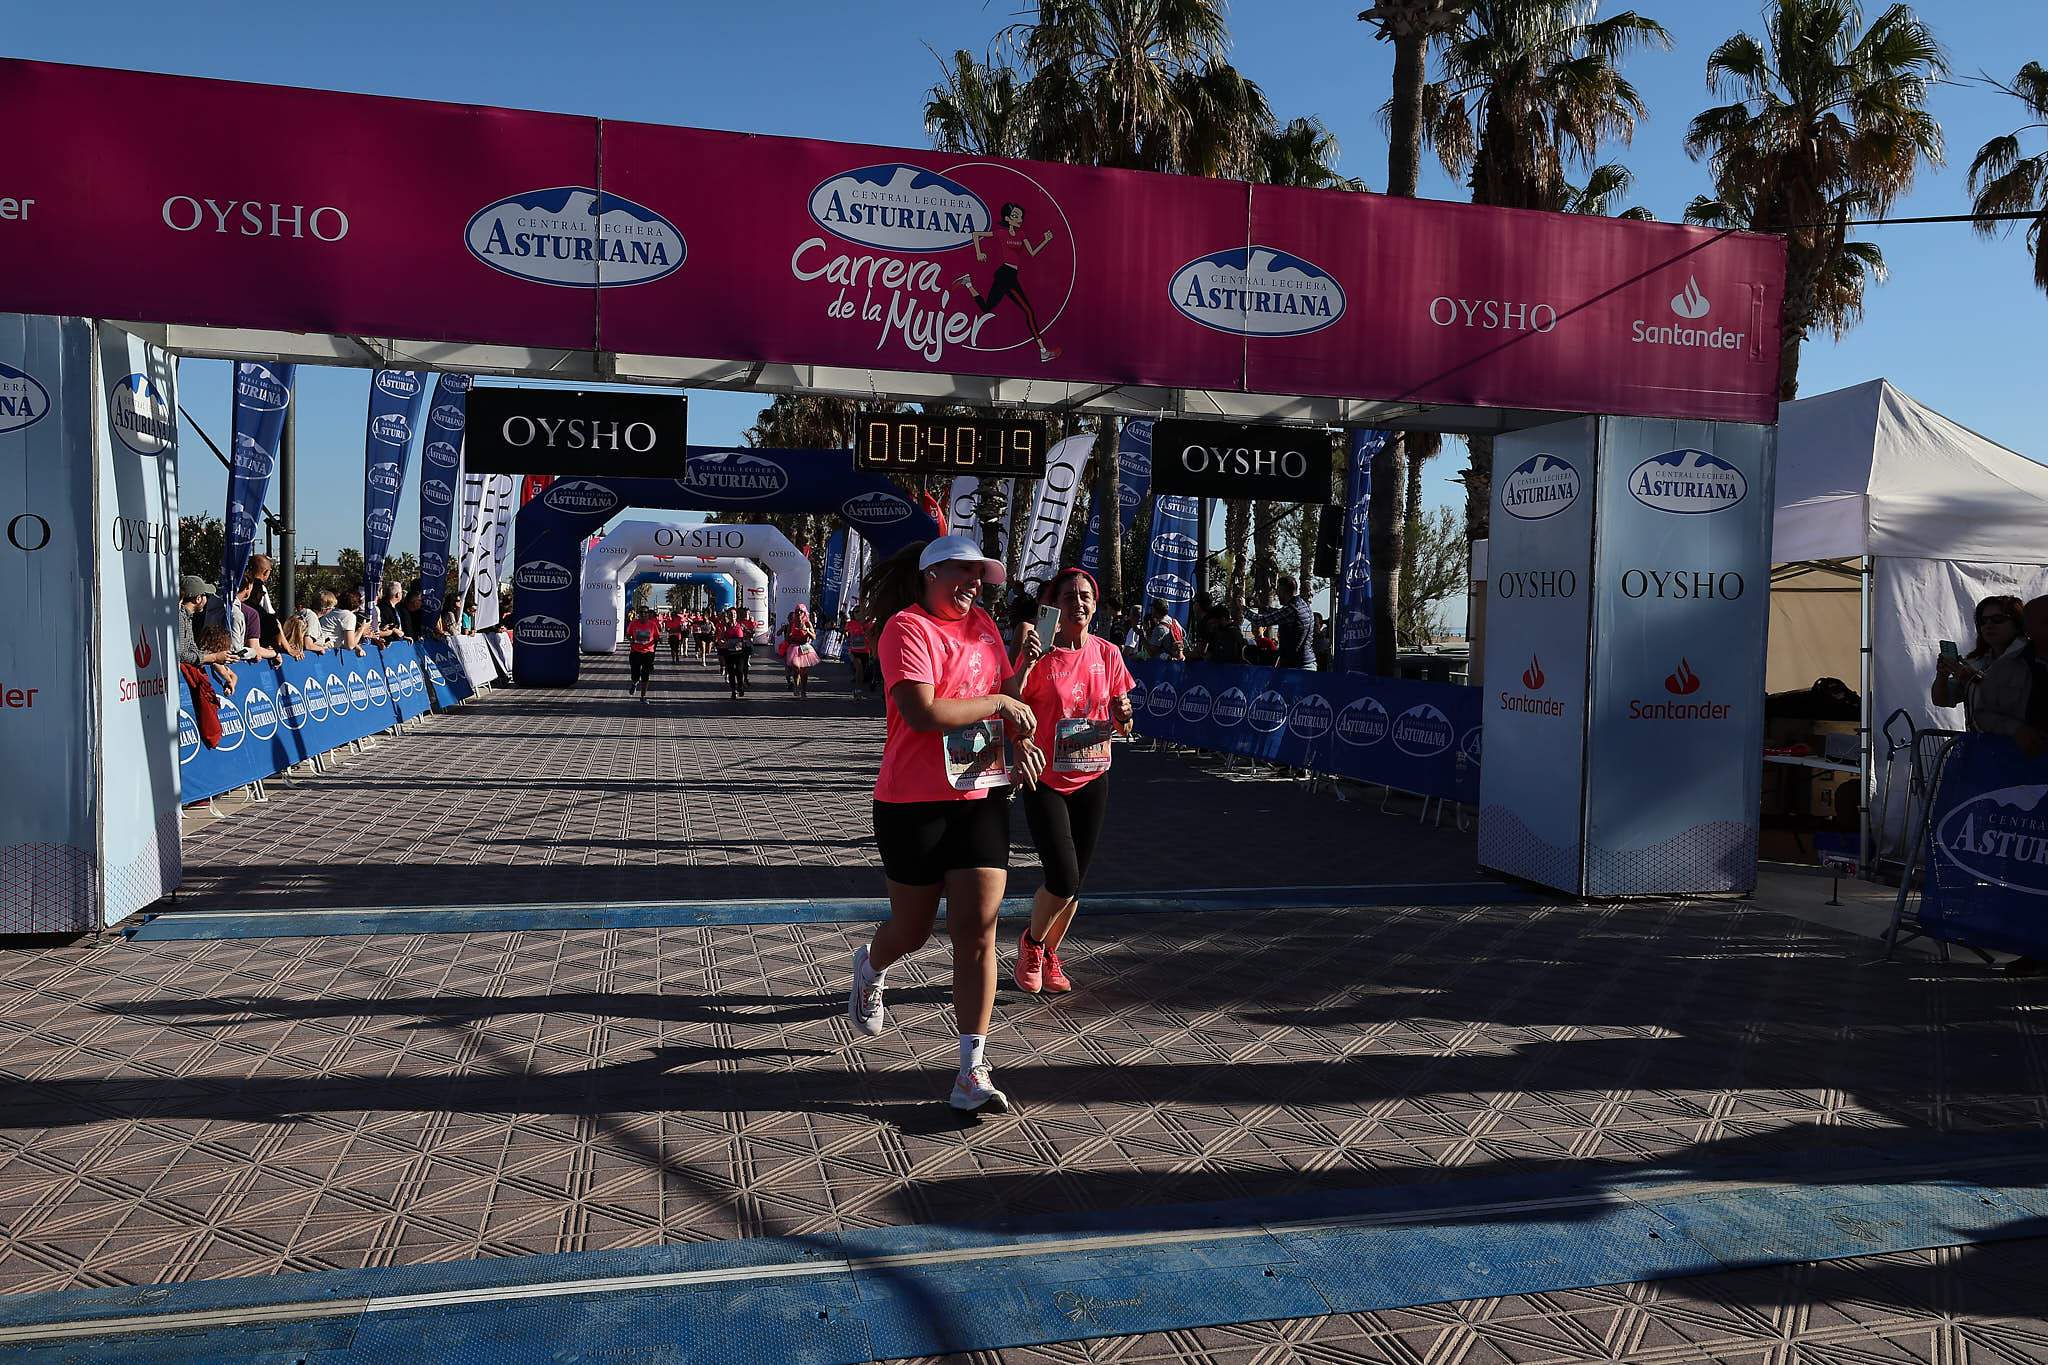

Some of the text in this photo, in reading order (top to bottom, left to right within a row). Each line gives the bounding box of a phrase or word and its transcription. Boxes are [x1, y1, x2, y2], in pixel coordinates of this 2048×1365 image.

[823, 189, 977, 234] ASTURIANA
[851, 190, 973, 209] CENTRAL LECHERA
[162, 195, 349, 242] OYSHO
[517, 217, 664, 238] CENTRAL ECHERA
[482, 218, 670, 266] ASTURIANA
[791, 237, 942, 293] Carrera
[1182, 273, 1333, 318] ASTURIANA
[1210, 274, 1329, 291] CENTRAL LECHERA
[827, 288, 882, 321] de la
[1429, 295, 1557, 334] OYSHO
[876, 289, 997, 363] Mujer
[1632, 319, 1745, 351] Santander
[502, 415, 657, 452] OYSHO
[868, 422, 1032, 465] 00:40:19
[682, 464, 780, 489] ASTURIANA
[1181, 445, 1308, 478] OYSHO
[546, 490, 613, 507] ASTURIANA
[1505, 481, 1574, 506] ASTURIANA
[1636, 471, 1738, 499] ASTURIANA
[848, 502, 913, 517] ASTURIANA
[113, 516, 171, 556] OYSHO
[654, 528, 744, 549] OYSHO
[1499, 569, 1576, 599] OYSHO
[1621, 569, 1744, 600] OYSHO
[119, 675, 169, 702] Santander
[1501, 692, 1564, 717] Santander
[1629, 700, 1732, 720] Santander
[1395, 719, 1446, 747] ASTURIANA
